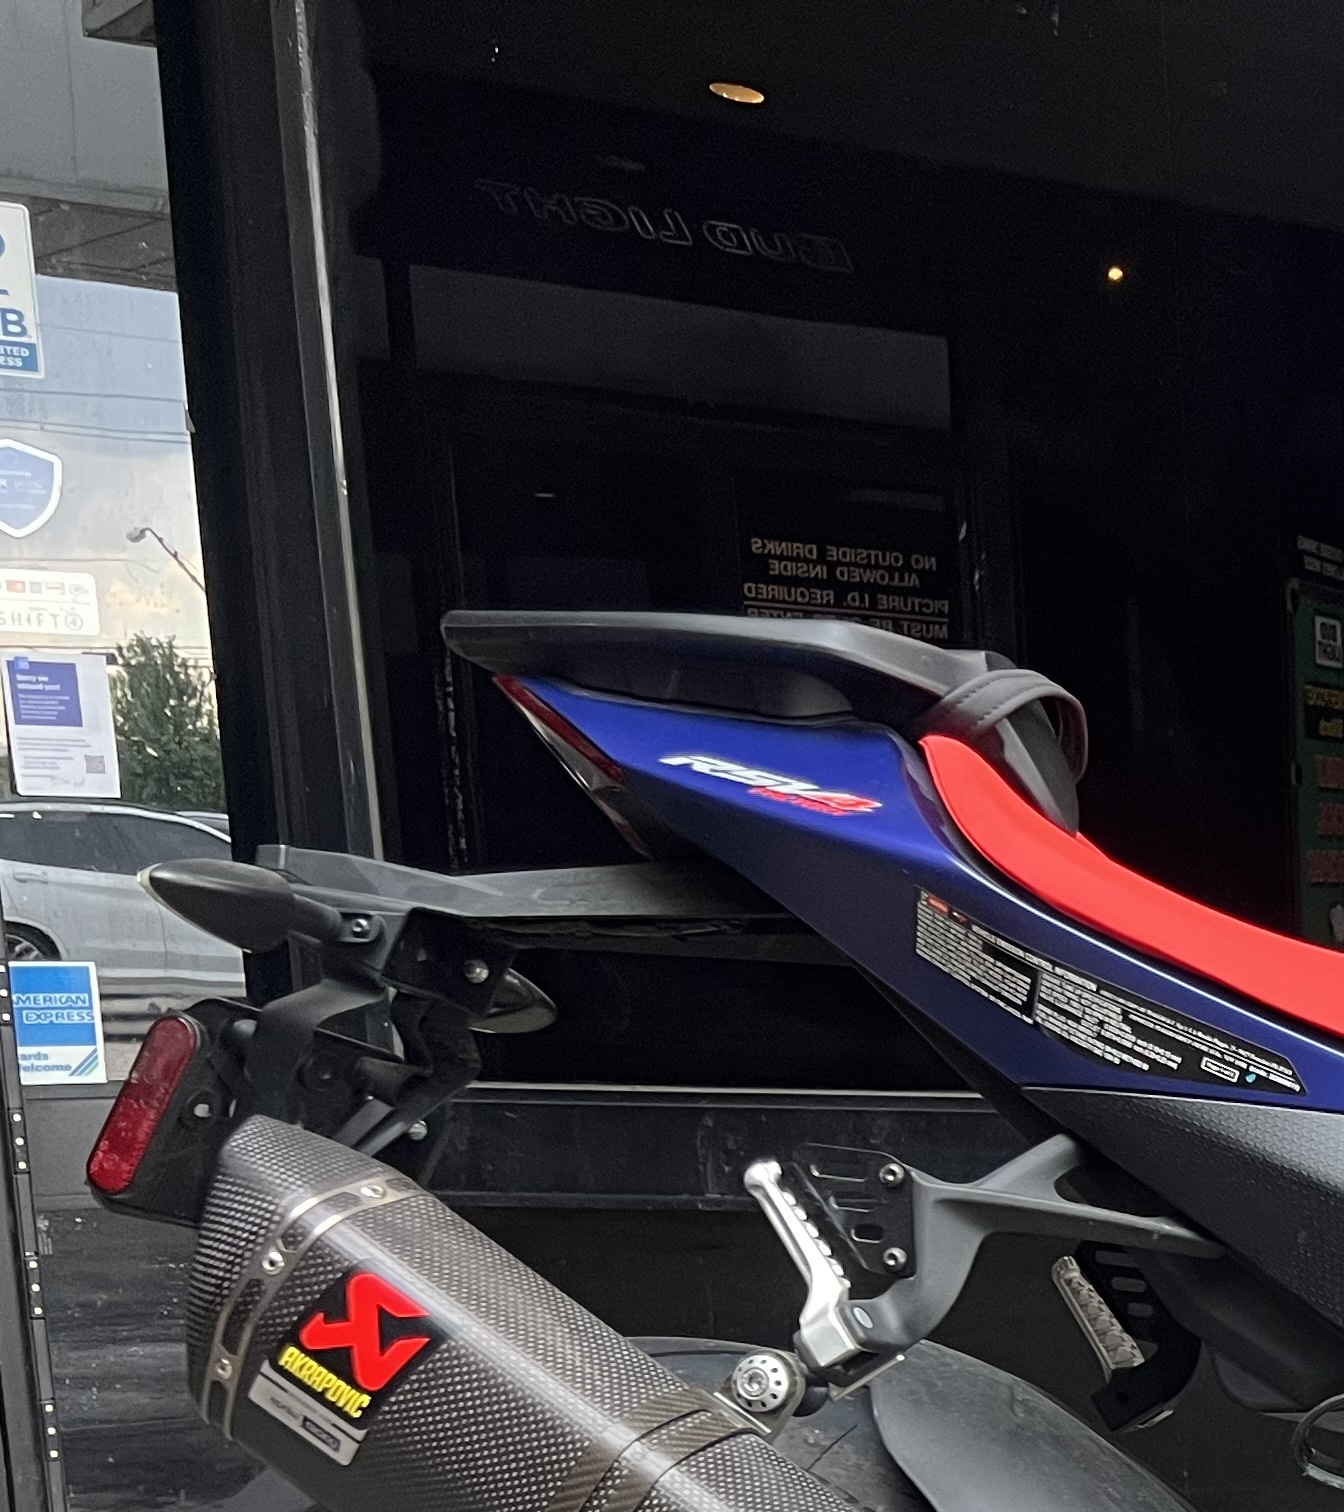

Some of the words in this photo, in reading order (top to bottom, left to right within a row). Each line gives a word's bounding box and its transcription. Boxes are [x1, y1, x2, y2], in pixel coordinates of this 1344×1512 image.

[13, 993, 88, 1006] MERICAN
[24, 1011, 95, 1022] EXPRESS
[20, 1051, 49, 1061] ards
[20, 1063, 72, 1072] elcome
